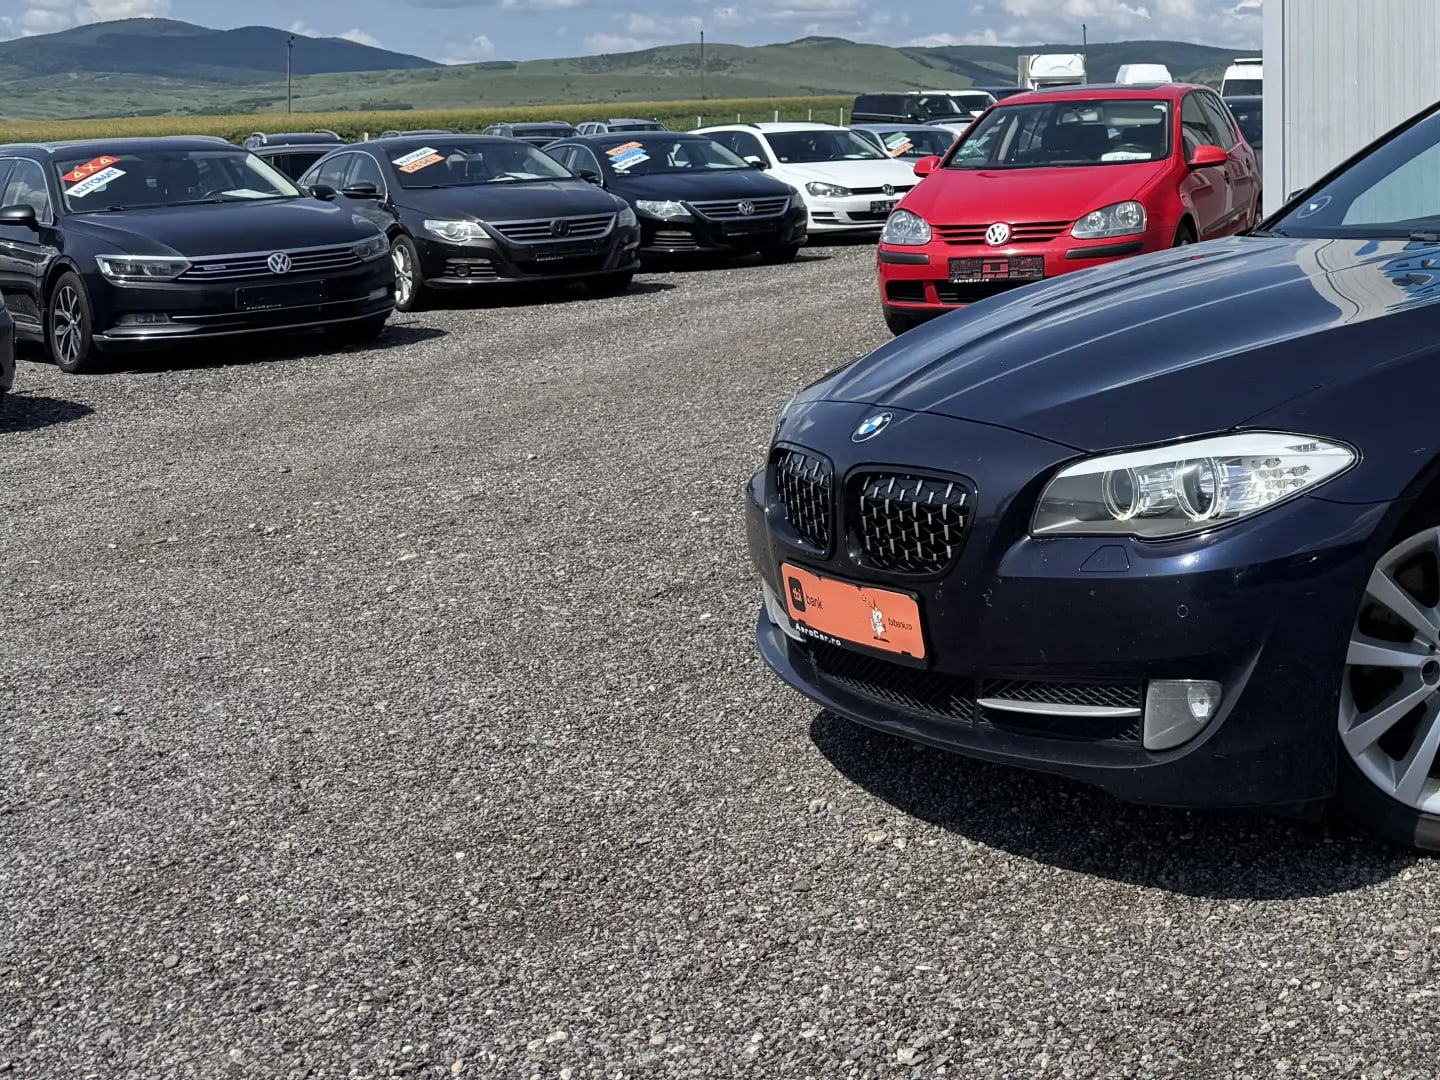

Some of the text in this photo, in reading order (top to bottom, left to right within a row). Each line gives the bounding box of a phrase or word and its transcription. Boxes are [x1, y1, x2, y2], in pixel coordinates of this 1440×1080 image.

[73, 168, 118, 195] AUTOMAT
[805, 592, 824, 610] bank
[795, 622, 842, 647] AeroCar.ro
